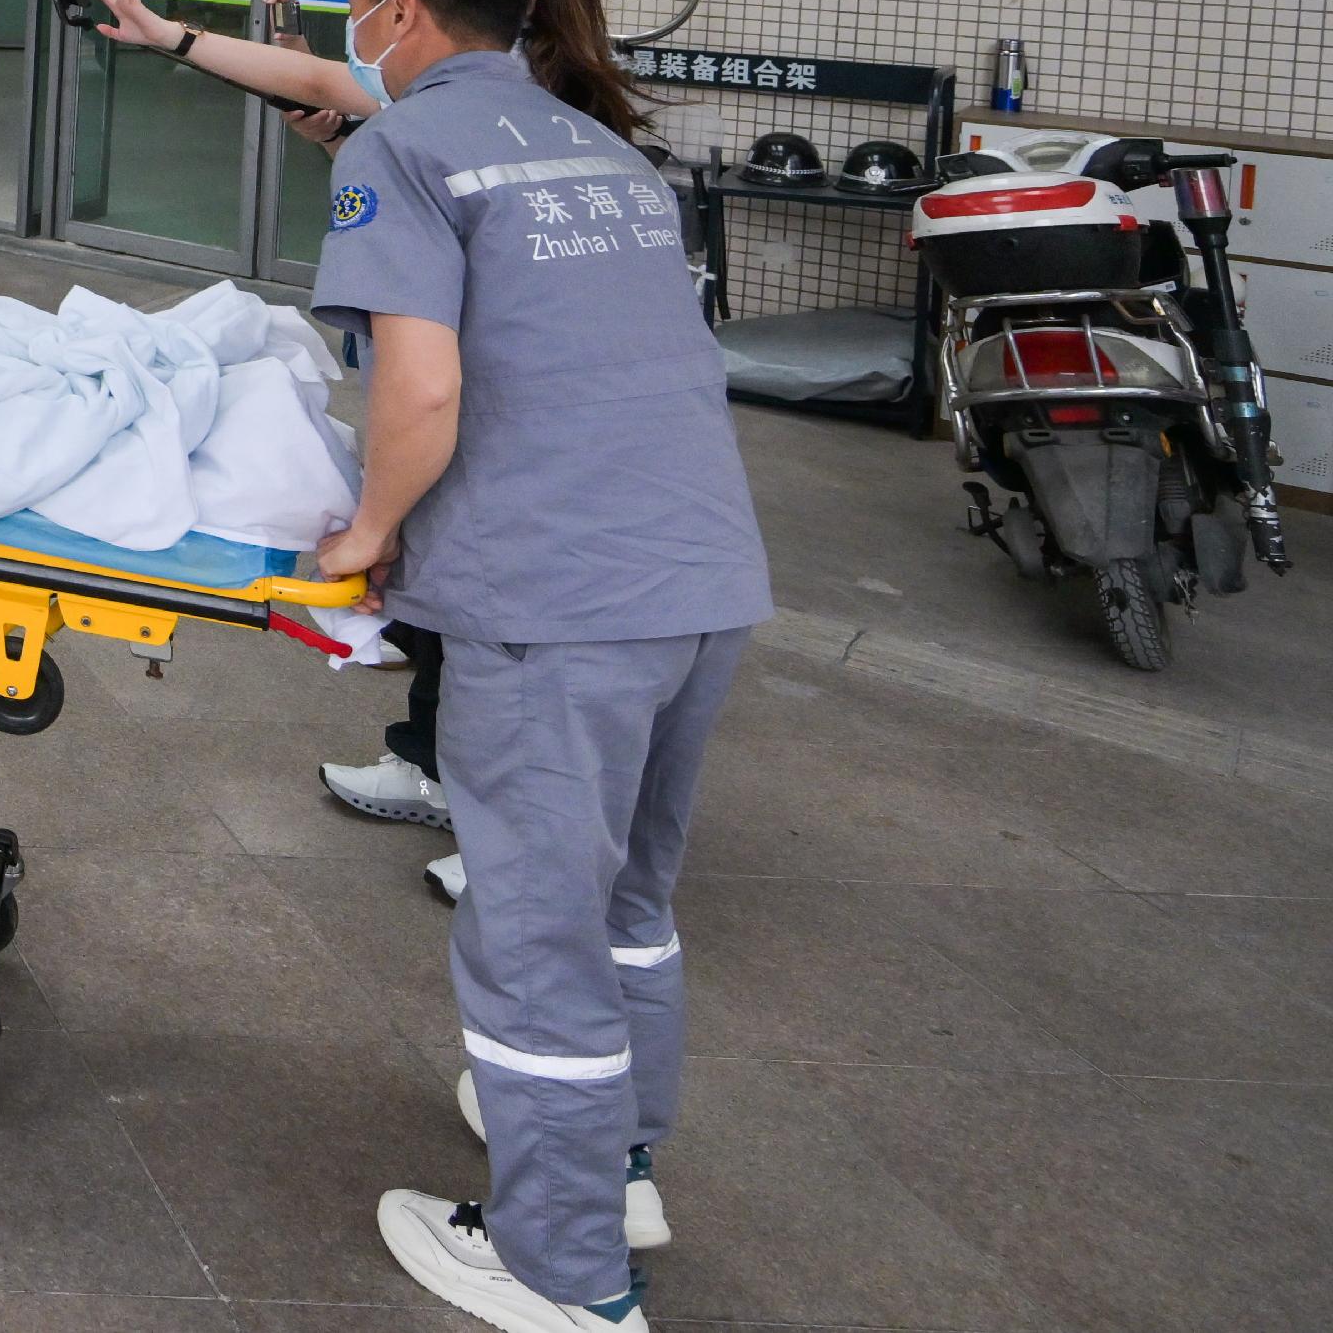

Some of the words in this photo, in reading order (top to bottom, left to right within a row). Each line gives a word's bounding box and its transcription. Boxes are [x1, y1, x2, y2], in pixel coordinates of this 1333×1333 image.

[612, 49, 818, 91] 暴装备组合架
[526, 226, 620, 261] Zhuhai
